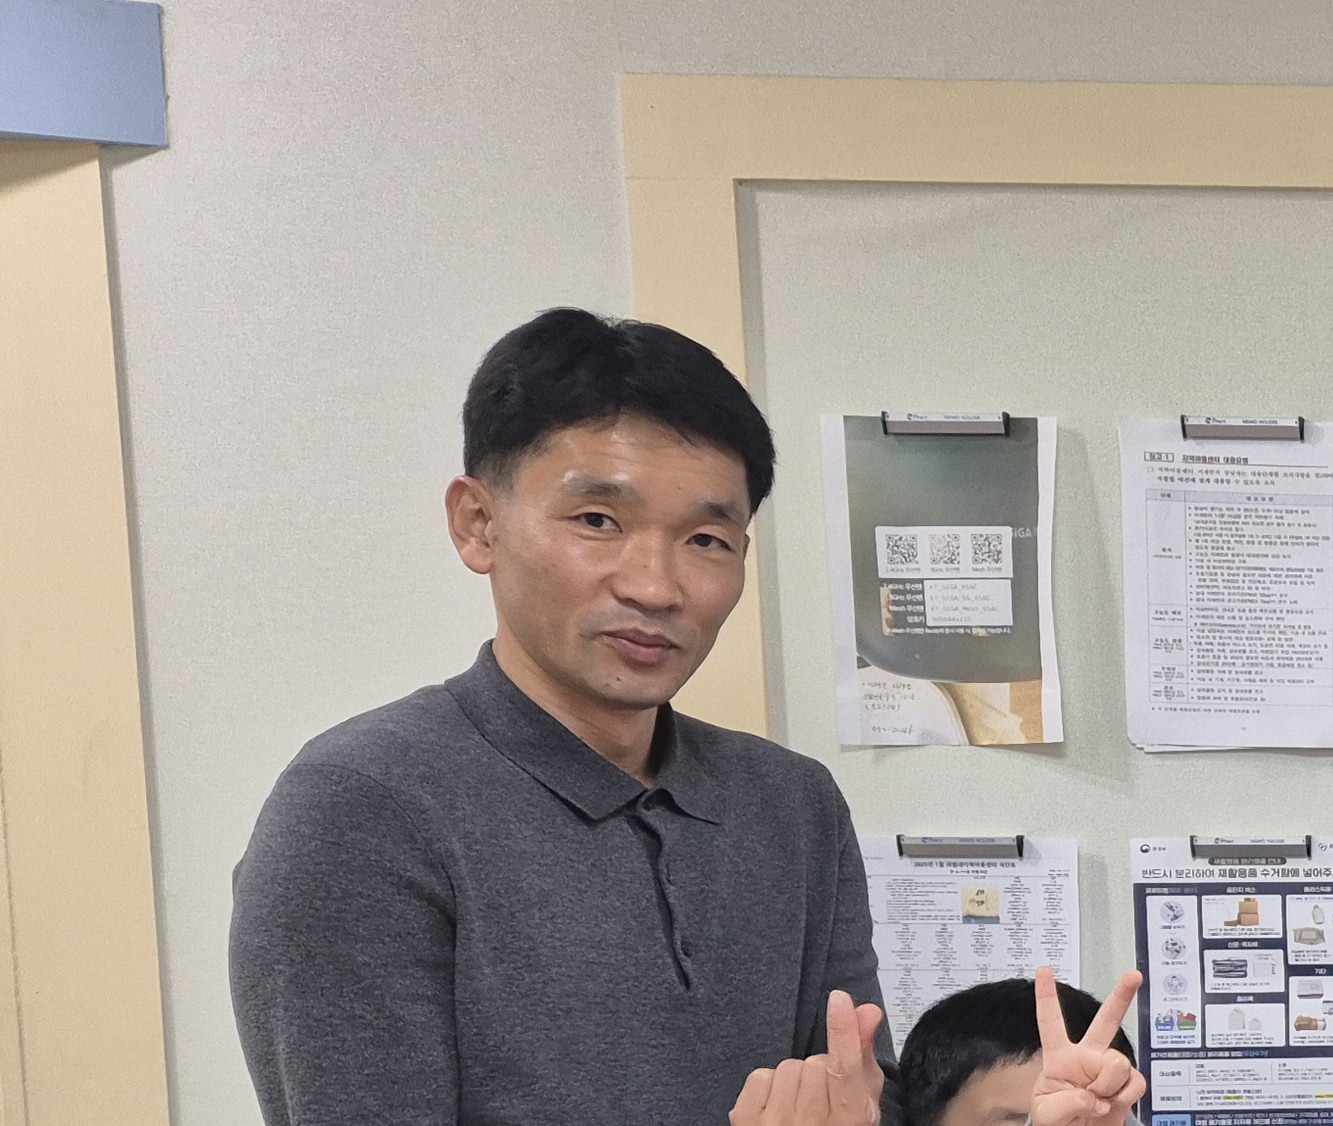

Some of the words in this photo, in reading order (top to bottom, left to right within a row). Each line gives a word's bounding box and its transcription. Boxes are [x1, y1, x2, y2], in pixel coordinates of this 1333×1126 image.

[1141, 868, 1172, 879] 반드시
[1174, 868, 1214, 878] 분리하여
[1217, 867, 1257, 878] 재활용품
[1260, 867, 1300, 877] 수거함에
